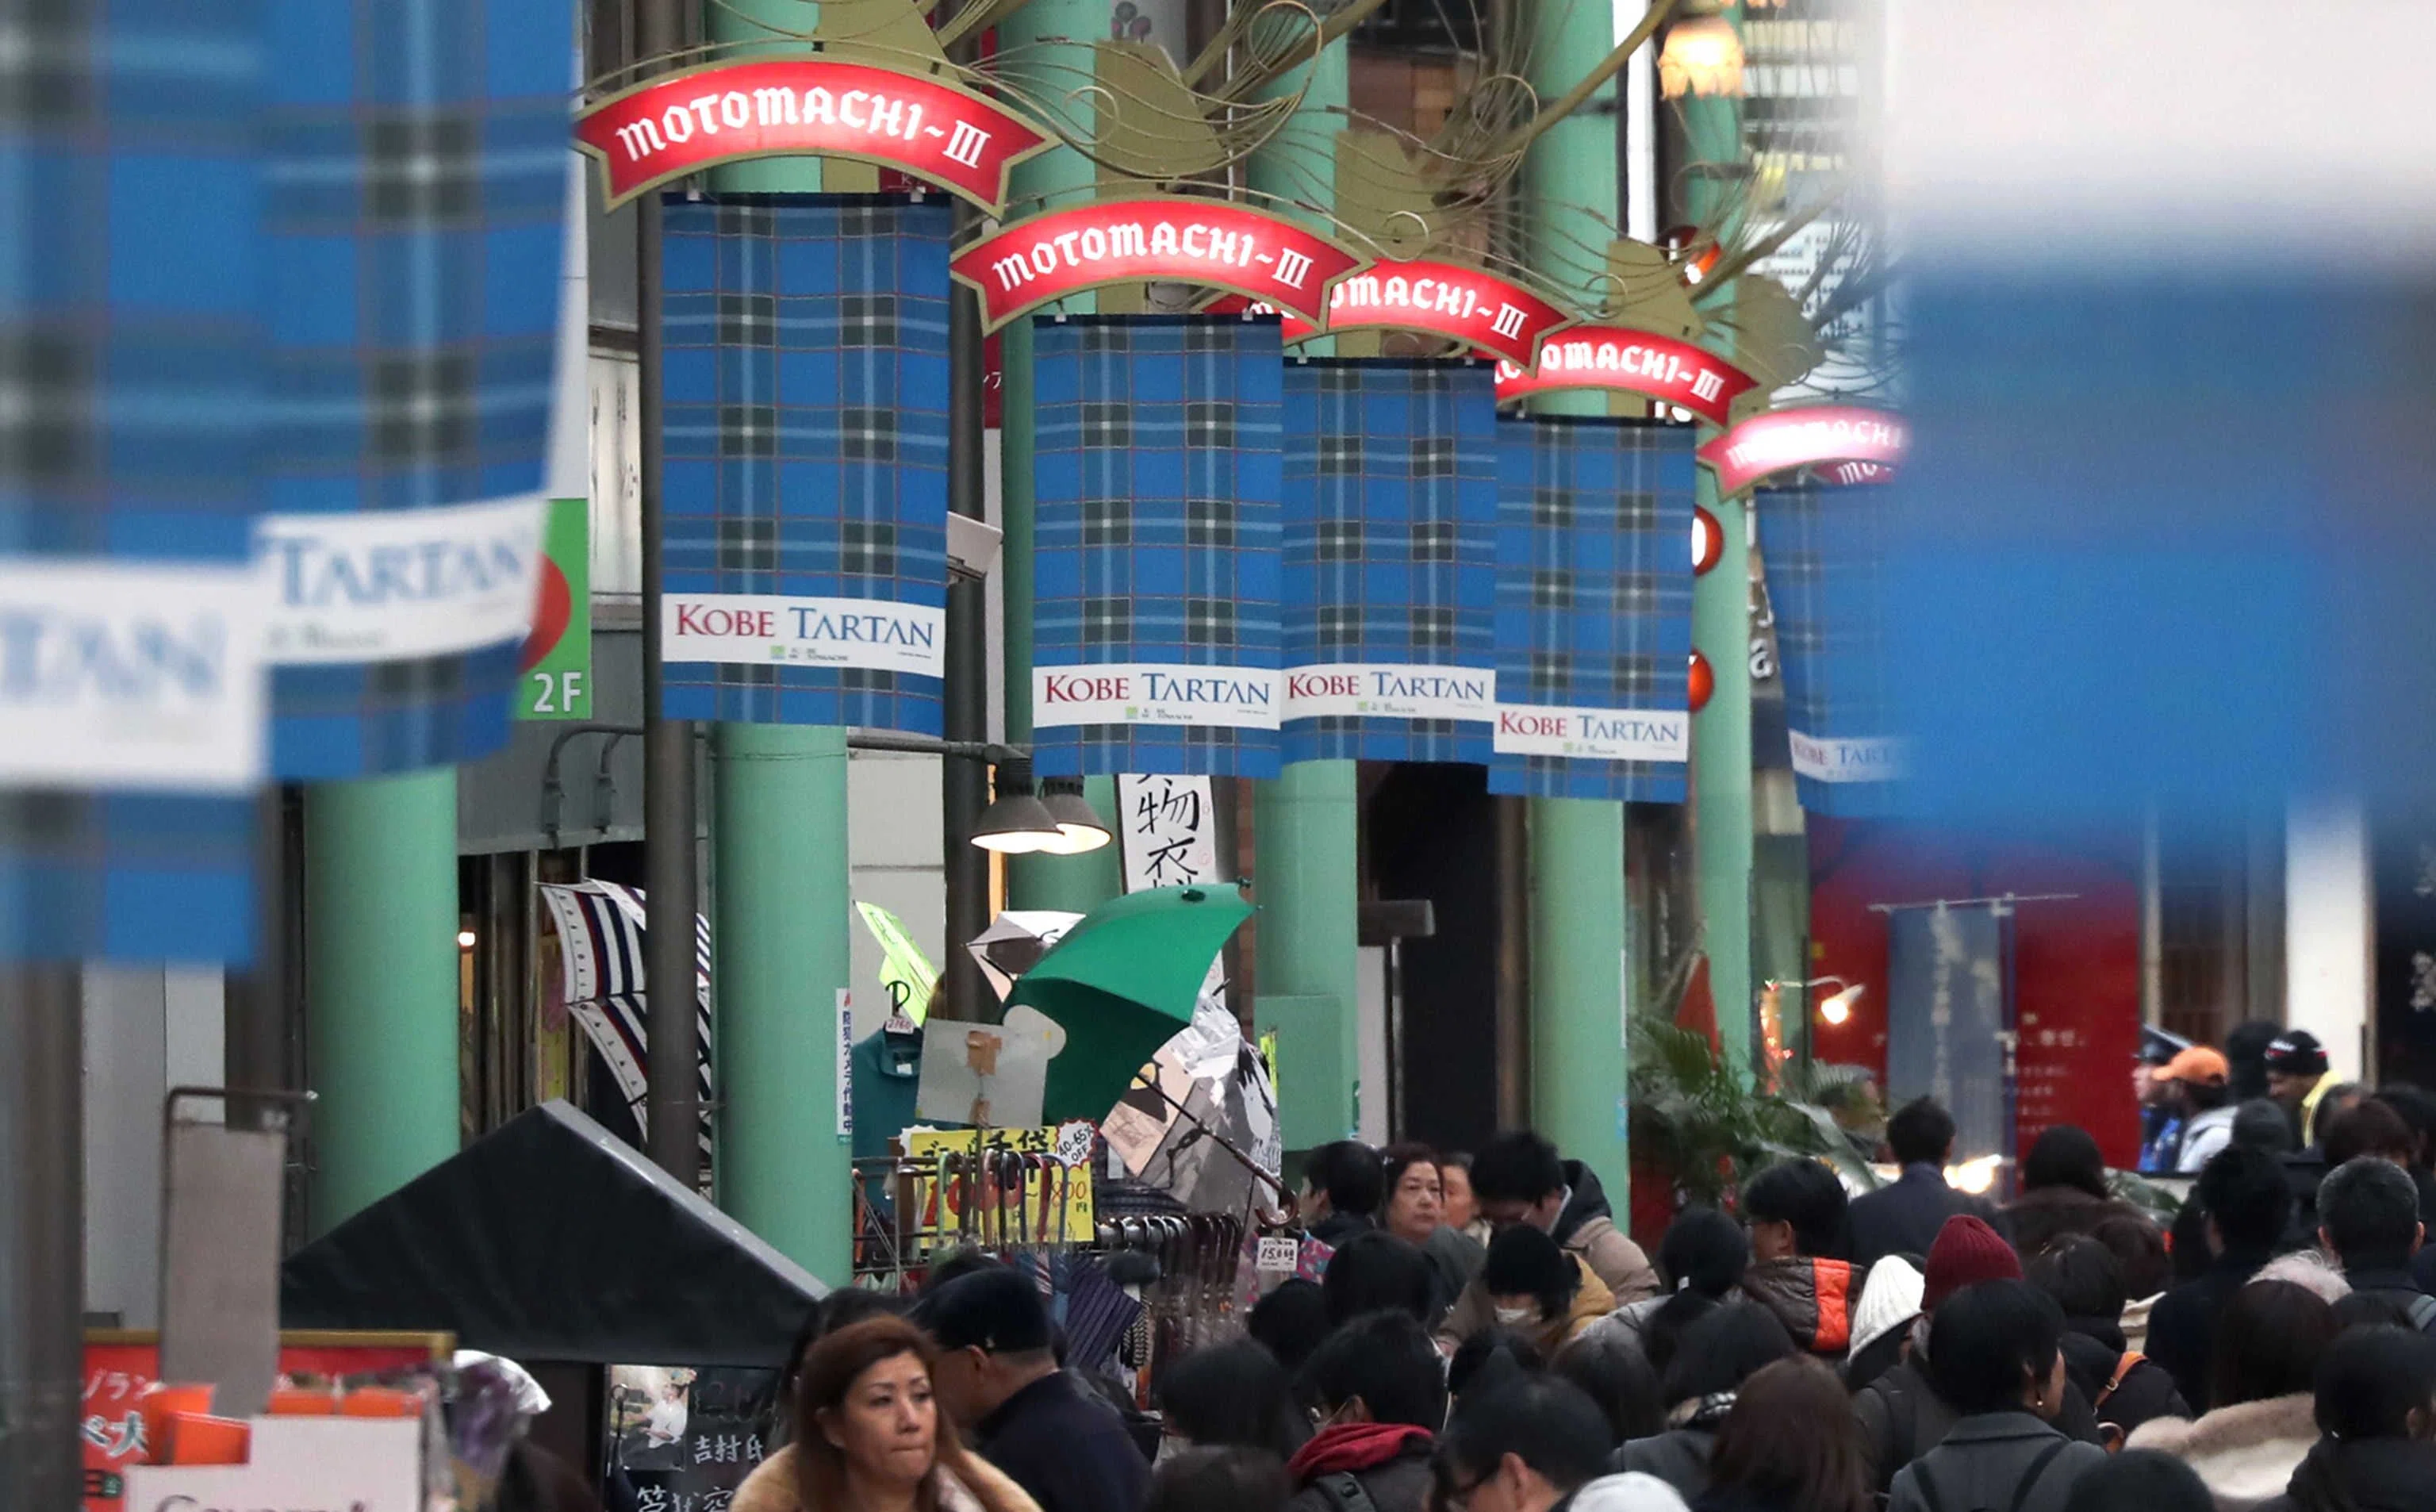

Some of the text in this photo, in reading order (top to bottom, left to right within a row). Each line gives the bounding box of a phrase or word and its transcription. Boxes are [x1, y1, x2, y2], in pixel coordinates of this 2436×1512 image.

[675, 604, 934, 649] KOBE TARTAN
[532, 671, 582, 713] 2F
[1045, 673, 1270, 704] KOBE TARTAN
[1288, 672, 1484, 700] KOBE TARTAN
[1500, 711, 1678, 742] KOBE TARTAN
[1071, 1143, 1087, 1161] OFF
